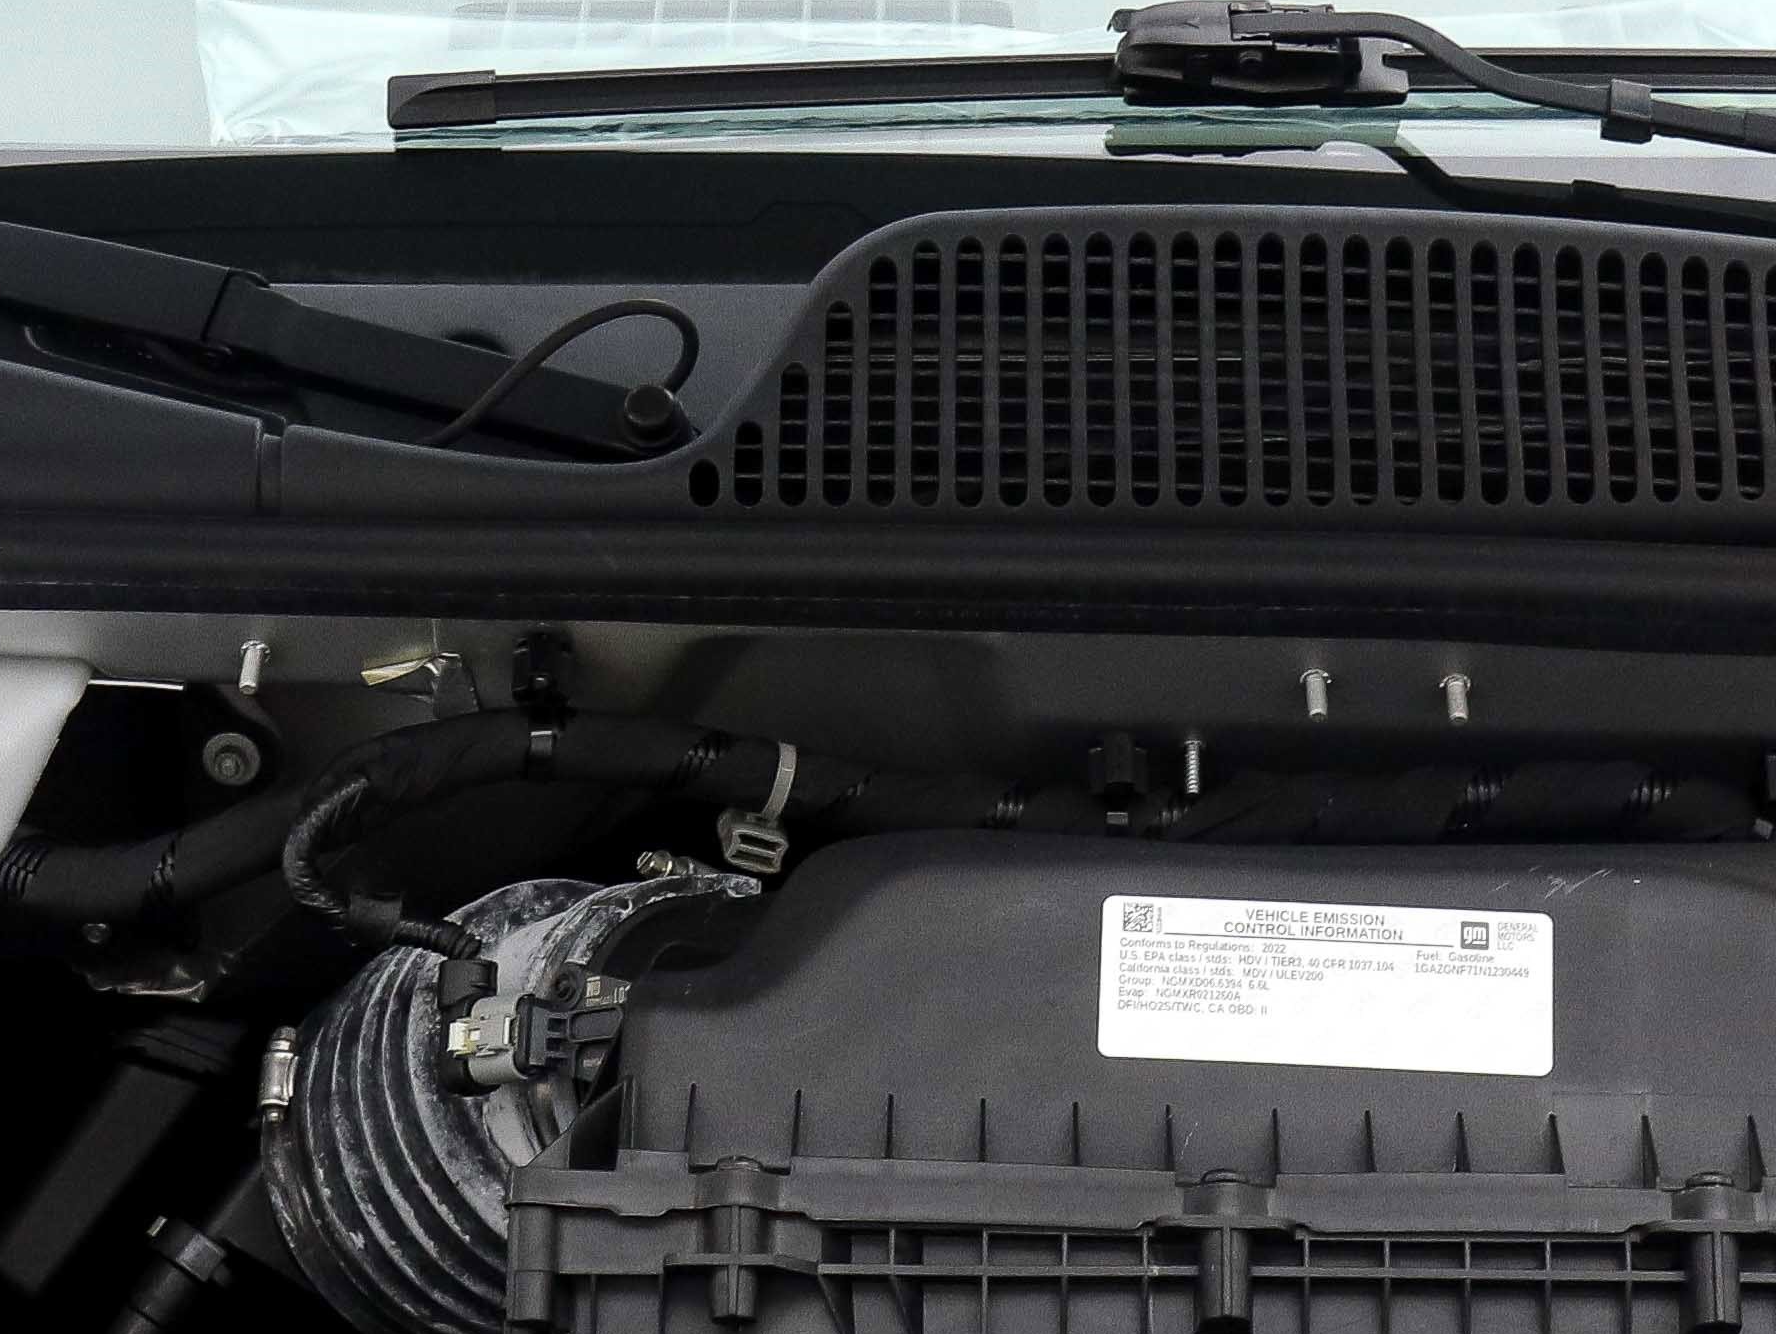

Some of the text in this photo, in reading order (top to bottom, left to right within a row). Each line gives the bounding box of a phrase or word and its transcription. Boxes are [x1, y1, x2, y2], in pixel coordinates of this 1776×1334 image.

[1246, 908, 1385, 927] VEHICLE EMISSION
[1224, 921, 1405, 941] CONTROL INFORMATION
[1497, 922, 1539, 933] GENERAL
[1462, 924, 1488, 947] gm
[1497, 931, 1536, 942] MOTORS
[1119, 937, 1172, 948] Conforms
[1174, 939, 1186, 949] to
[1262, 942, 1287, 954] 2022
[1497, 941, 1515, 951] LLC
[1144, 951, 1165, 961] EPA
[1168, 952, 1196, 963] class
[1448, 952, 1495, 963] Gasoline
[1119, 962, 1170, 973] California
[1172, 964, 1200, 975] class
[1207, 1003, 1225, 1013] CA
